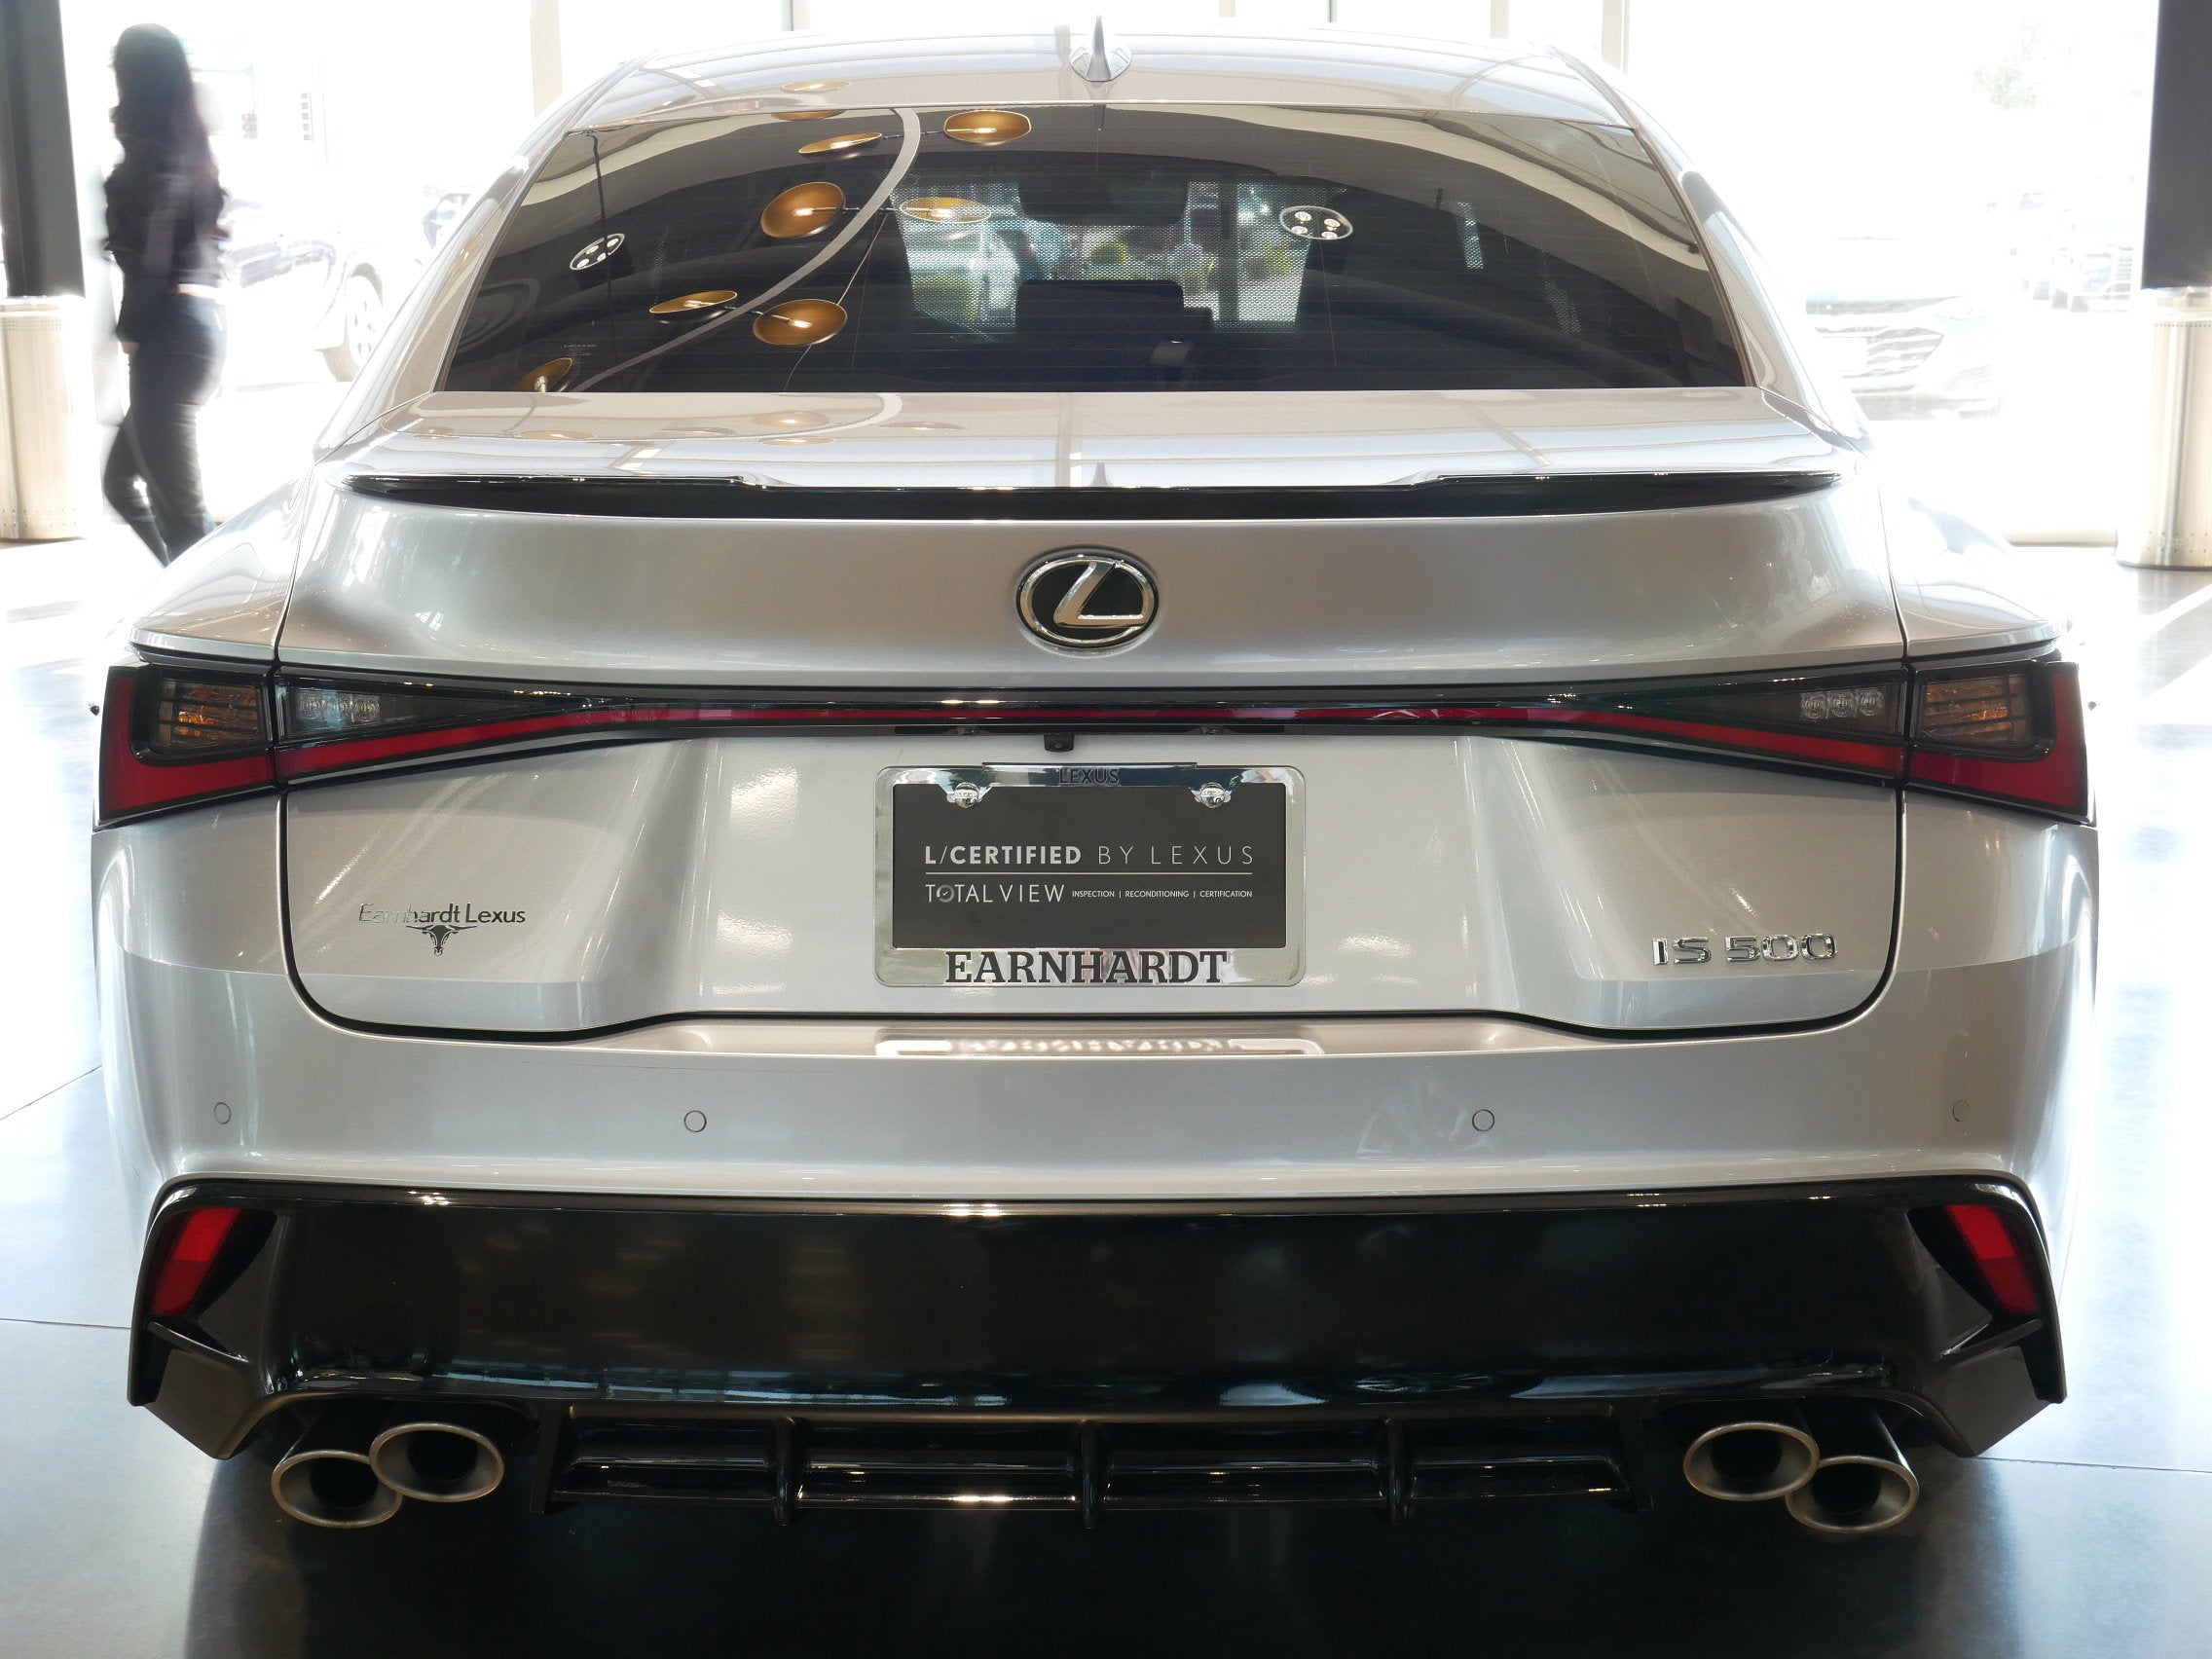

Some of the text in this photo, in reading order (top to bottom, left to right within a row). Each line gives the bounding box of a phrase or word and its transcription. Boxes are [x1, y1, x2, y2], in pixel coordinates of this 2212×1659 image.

[1059, 767, 1120, 784] LEXUS
[924, 845, 1253, 865] L/CERTIFIED BY LEXUS
[925, 883, 1253, 903] TOTAL VIEW INSPECTION RECONDITIONING CERTIFICATION
[358, 903, 526, 924] Earnhardt Lexus
[1652, 934, 1837, 966] IS 500
[944, 950, 1228, 984] EARNHARDT
